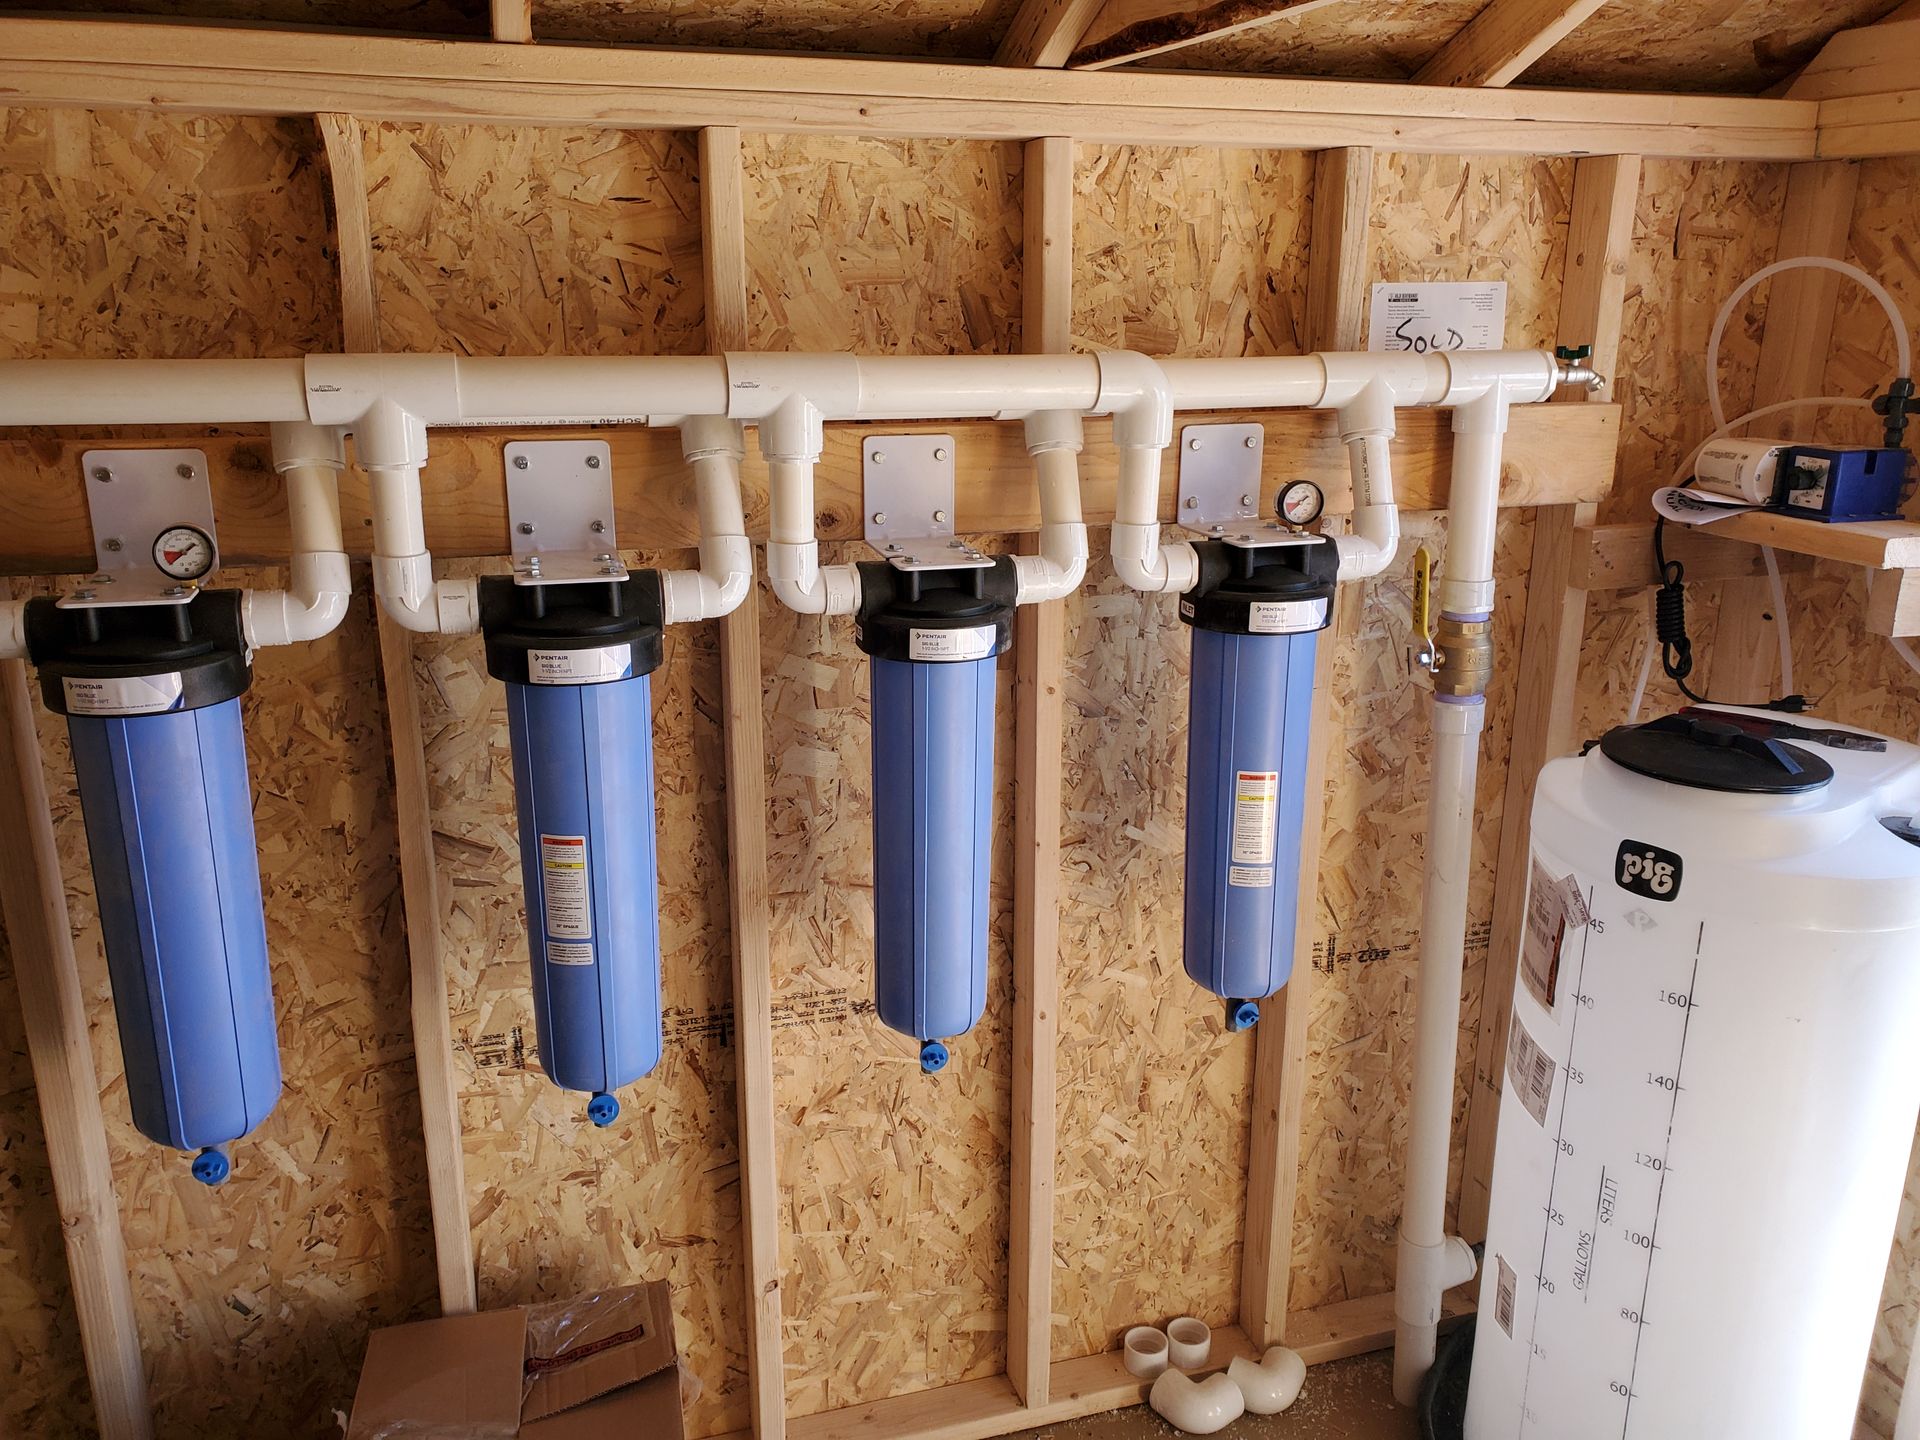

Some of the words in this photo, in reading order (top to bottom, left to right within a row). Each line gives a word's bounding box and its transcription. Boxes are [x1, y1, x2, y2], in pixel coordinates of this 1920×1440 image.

[1395, 317, 1463, 353] SOLD
[1621, 851, 1675, 894] pig
[1589, 918, 1605, 934] 45
[1579, 994, 1594, 1010] 40
[1659, 990, 1687, 1008] 160
[1569, 1067, 1584, 1084] 35
[1647, 1073, 1674, 1091] 140
[1559, 1140, 1574, 1156] 30
[1634, 1152, 1661, 1171] 120
[1600, 1177, 1618, 1224] LITERS
[1550, 1209, 1565, 1226] 25
[1624, 1230, 1650, 1249] 100
[1573, 1230, 1591, 1290] GALLONS
[1541, 1277, 1555, 1294] 20
[1620, 1307, 1639, 1324] 80
[1610, 1381, 1628, 1397] 60
